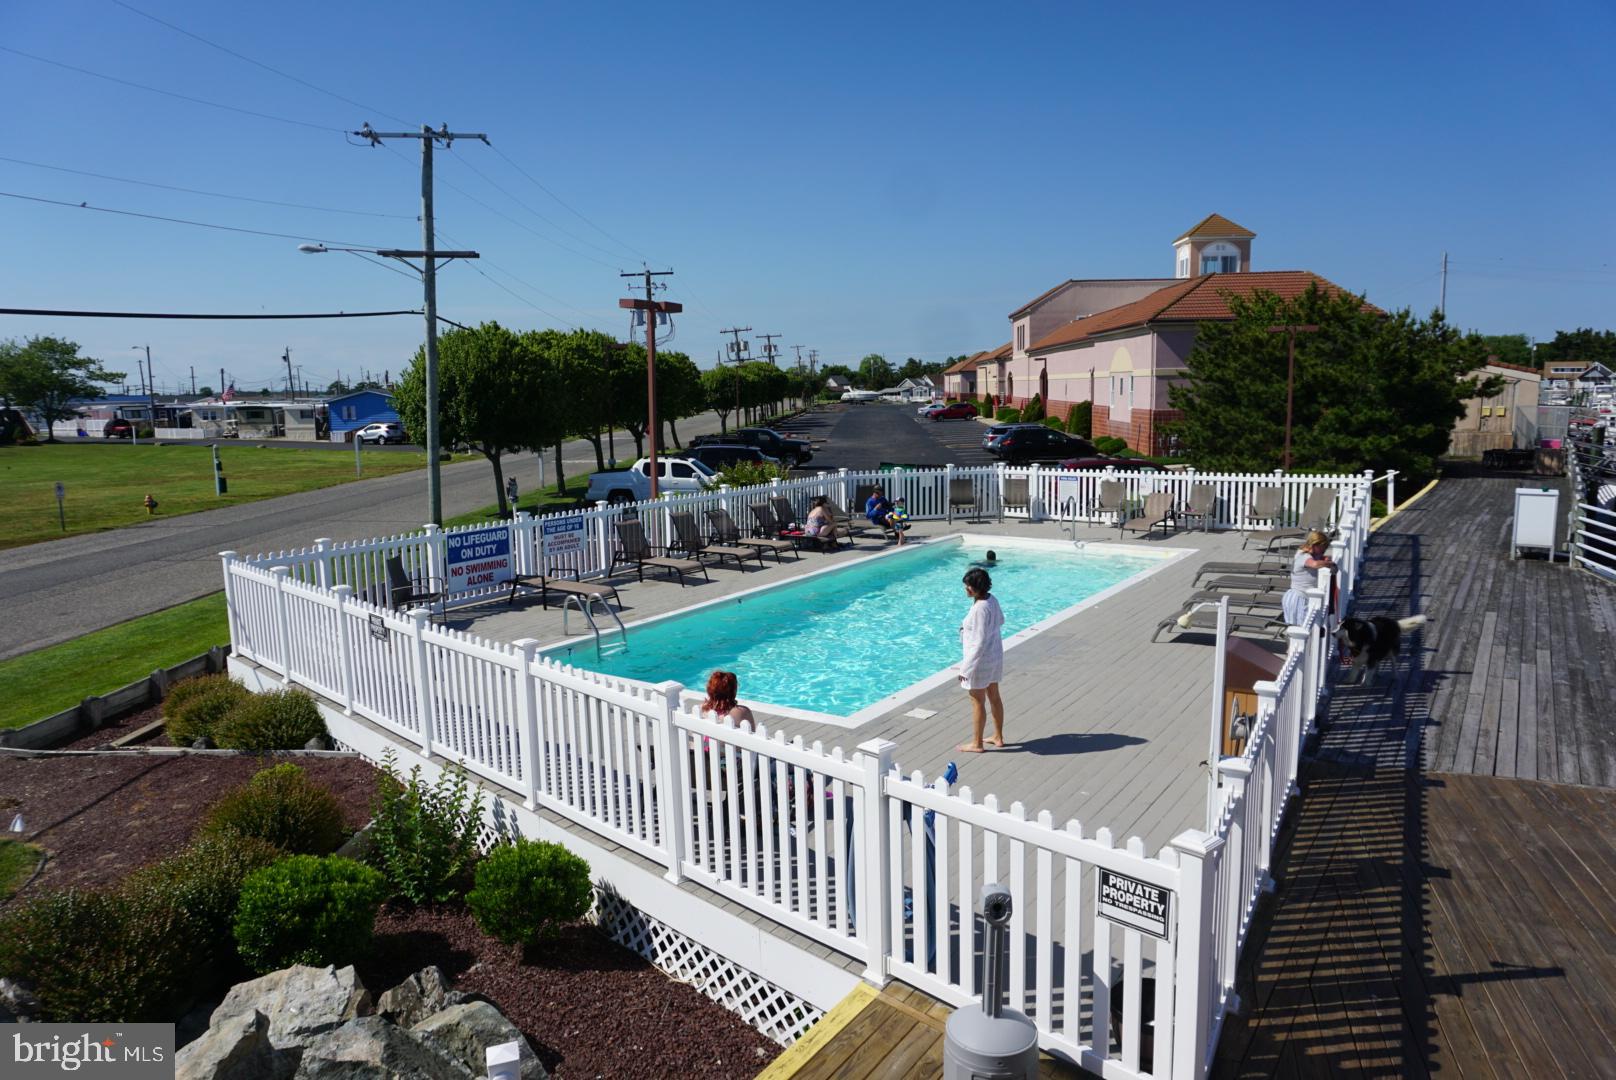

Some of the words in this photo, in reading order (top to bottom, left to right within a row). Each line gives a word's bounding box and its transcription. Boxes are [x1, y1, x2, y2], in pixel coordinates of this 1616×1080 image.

[545, 519, 566, 527] PERSONS
[449, 537, 461, 548] NO
[463, 530, 507, 546] LIFEGUARD
[461, 549, 473, 559] ON
[475, 544, 497, 556] DUTY
[451, 567, 463, 577] NO
[466, 559, 507, 574] SWIMMING
[467, 572, 494, 586] ALONE
[1109, 875, 1159, 902] PRIVATE
[1103, 885, 1165, 915] PROPERTY
[1115, 901, 1164, 922] TRESPASSING
